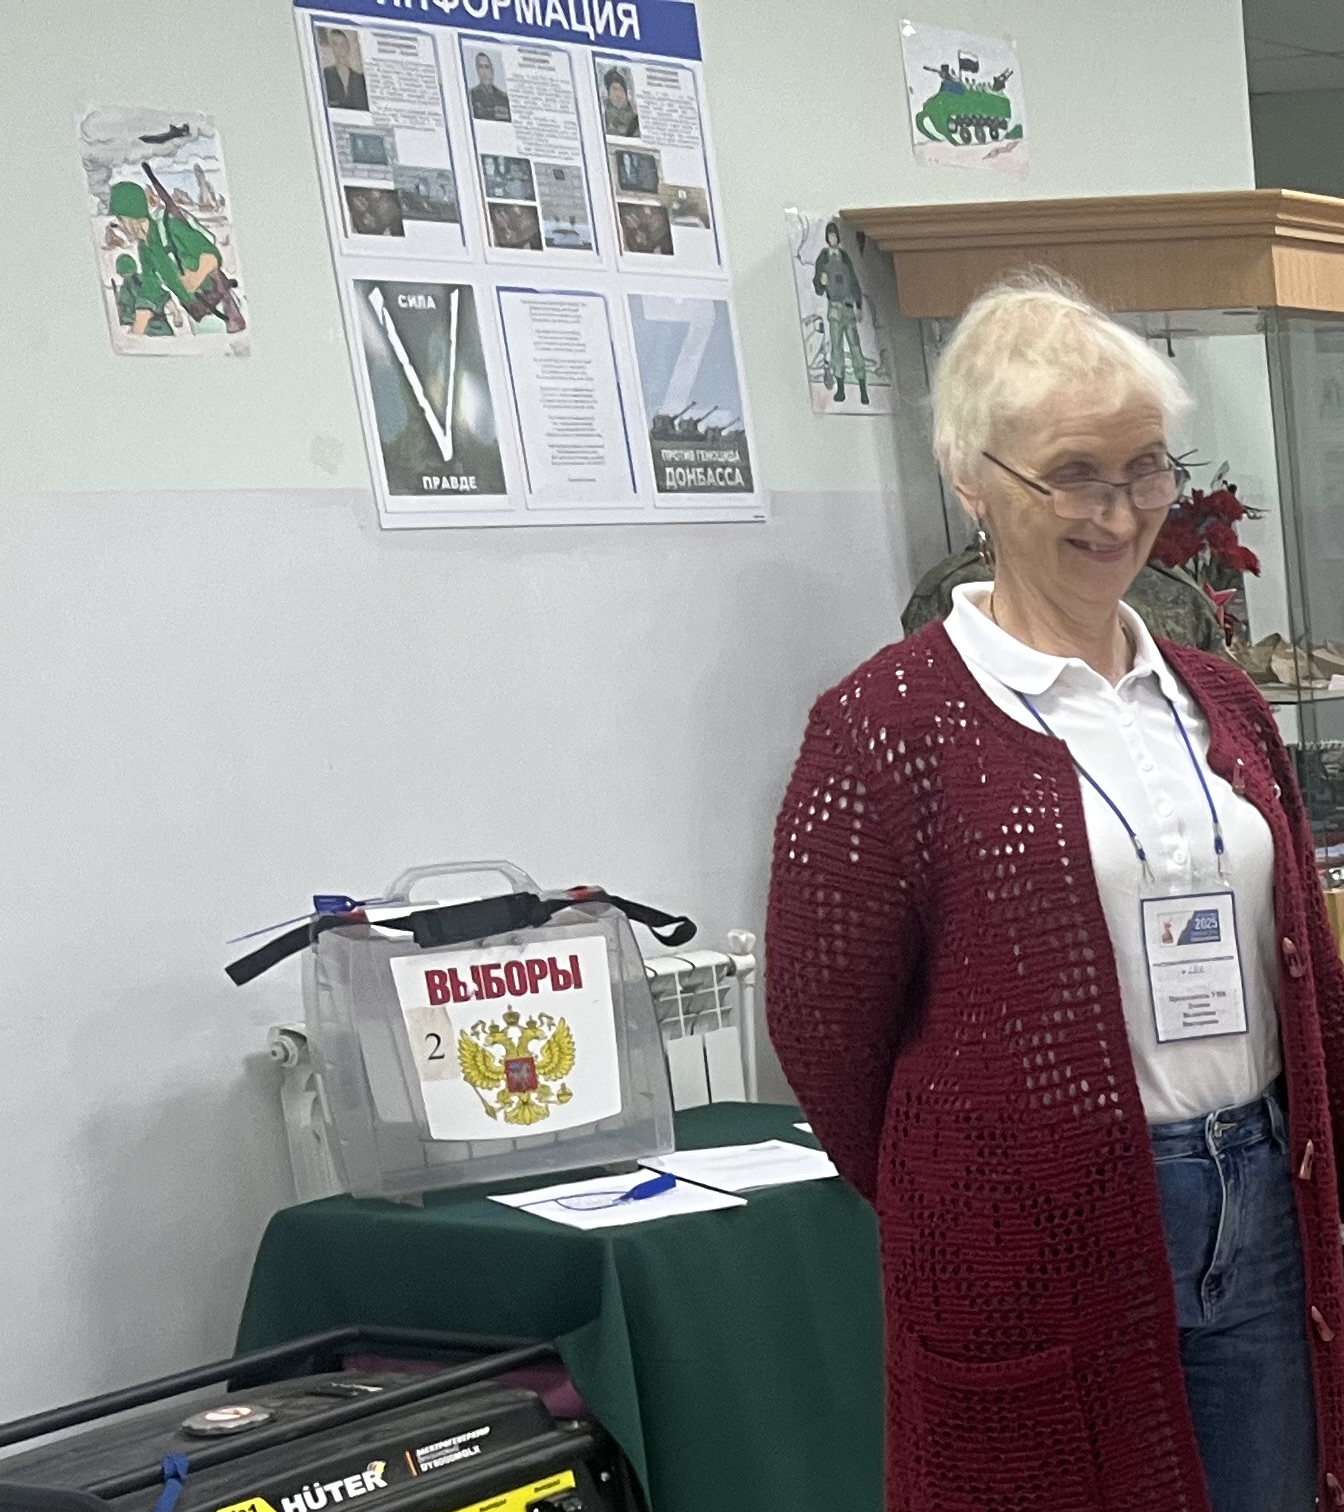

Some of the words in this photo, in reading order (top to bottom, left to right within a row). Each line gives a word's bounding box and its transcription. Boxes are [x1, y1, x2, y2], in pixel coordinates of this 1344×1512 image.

[377, 0, 641, 41] ОРМАЦИЯ
[398, 294, 437, 310] СИЛА
[422, 476, 477, 490] ПРАВДЕ
[665, 467, 745, 490] ДОНБАССА
[1195, 917, 1218, 930] 2025
[425, 955, 583, 1006] ВЫБОРЫ
[425, 1032, 445, 1061] 2
